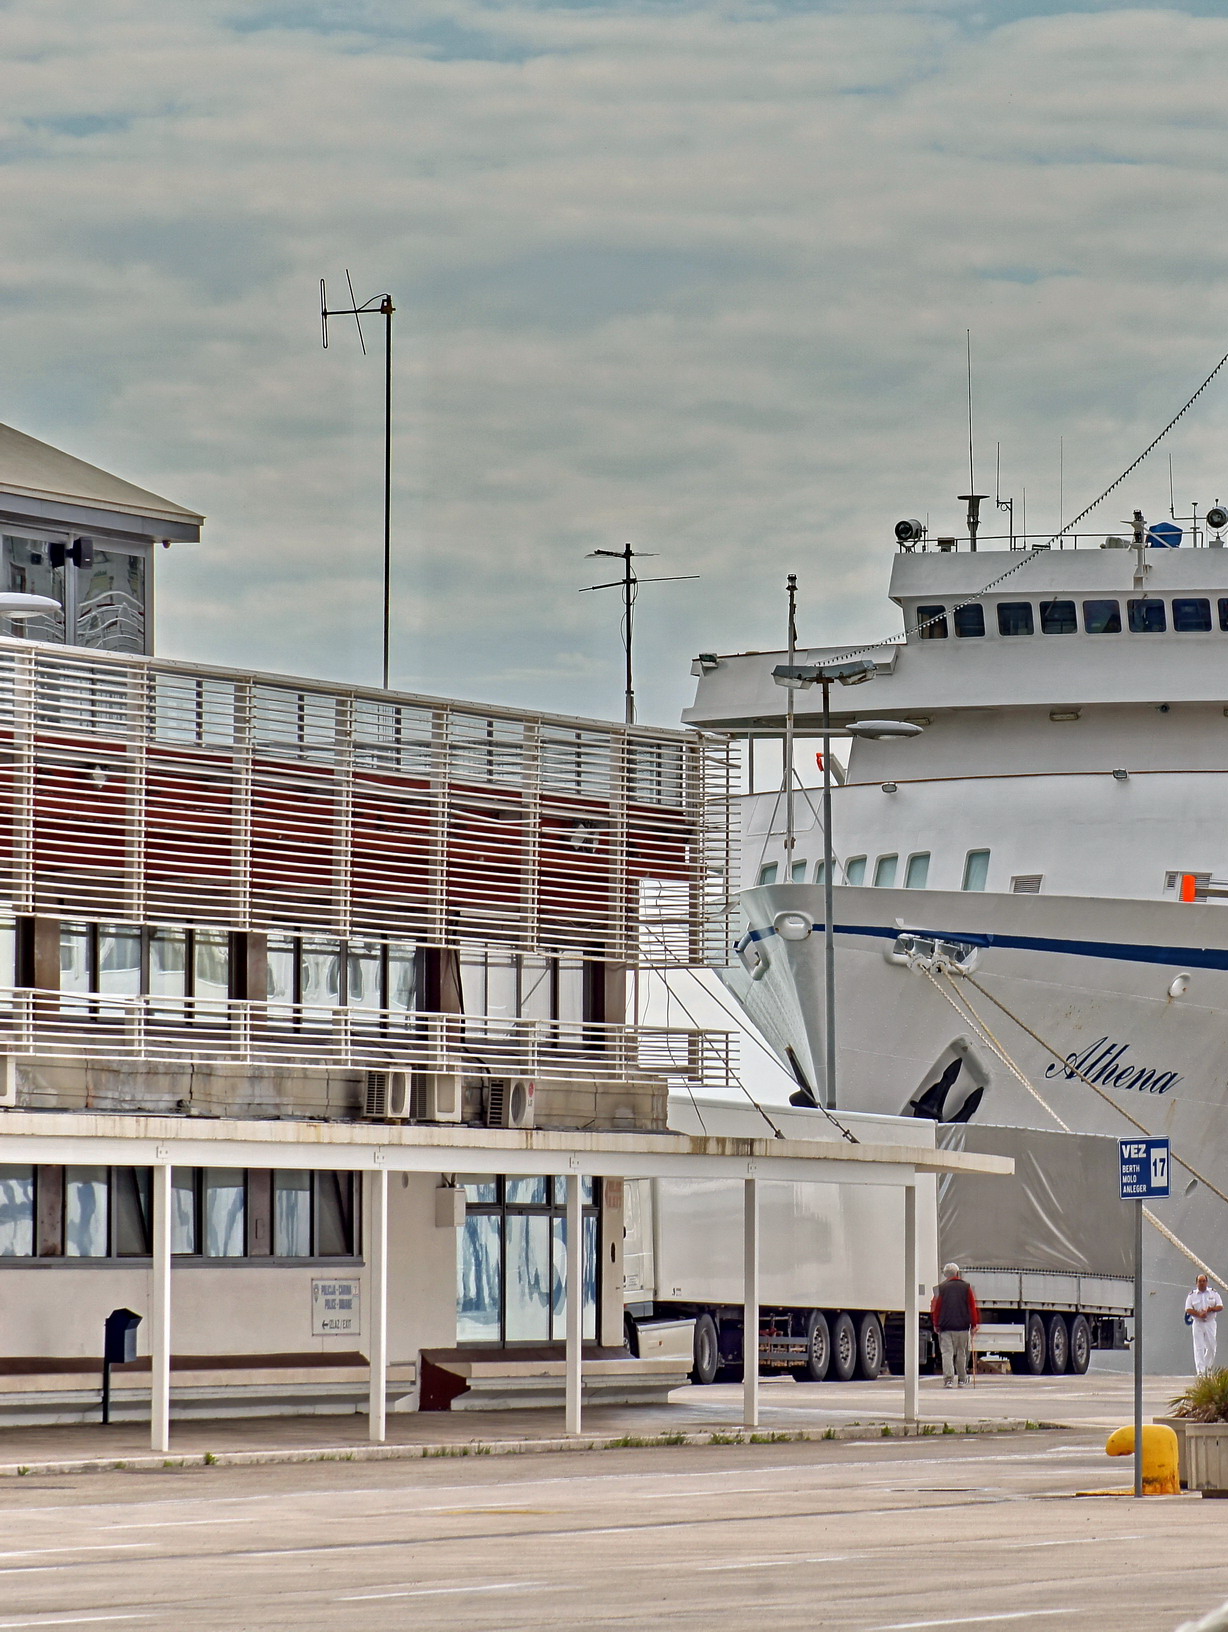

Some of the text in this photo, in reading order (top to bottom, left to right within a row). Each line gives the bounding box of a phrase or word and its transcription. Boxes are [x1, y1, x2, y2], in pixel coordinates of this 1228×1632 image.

[1045, 1036, 1184, 1094] Athena
[1121, 1144, 1147, 1158] VEZ
[1122, 1164, 1140, 1173] BERTH
[1152, 1158, 1166, 1177] 17
[1122, 1174, 1137, 1183] MOLO
[1123, 1184, 1147, 1194] ANLEGER
